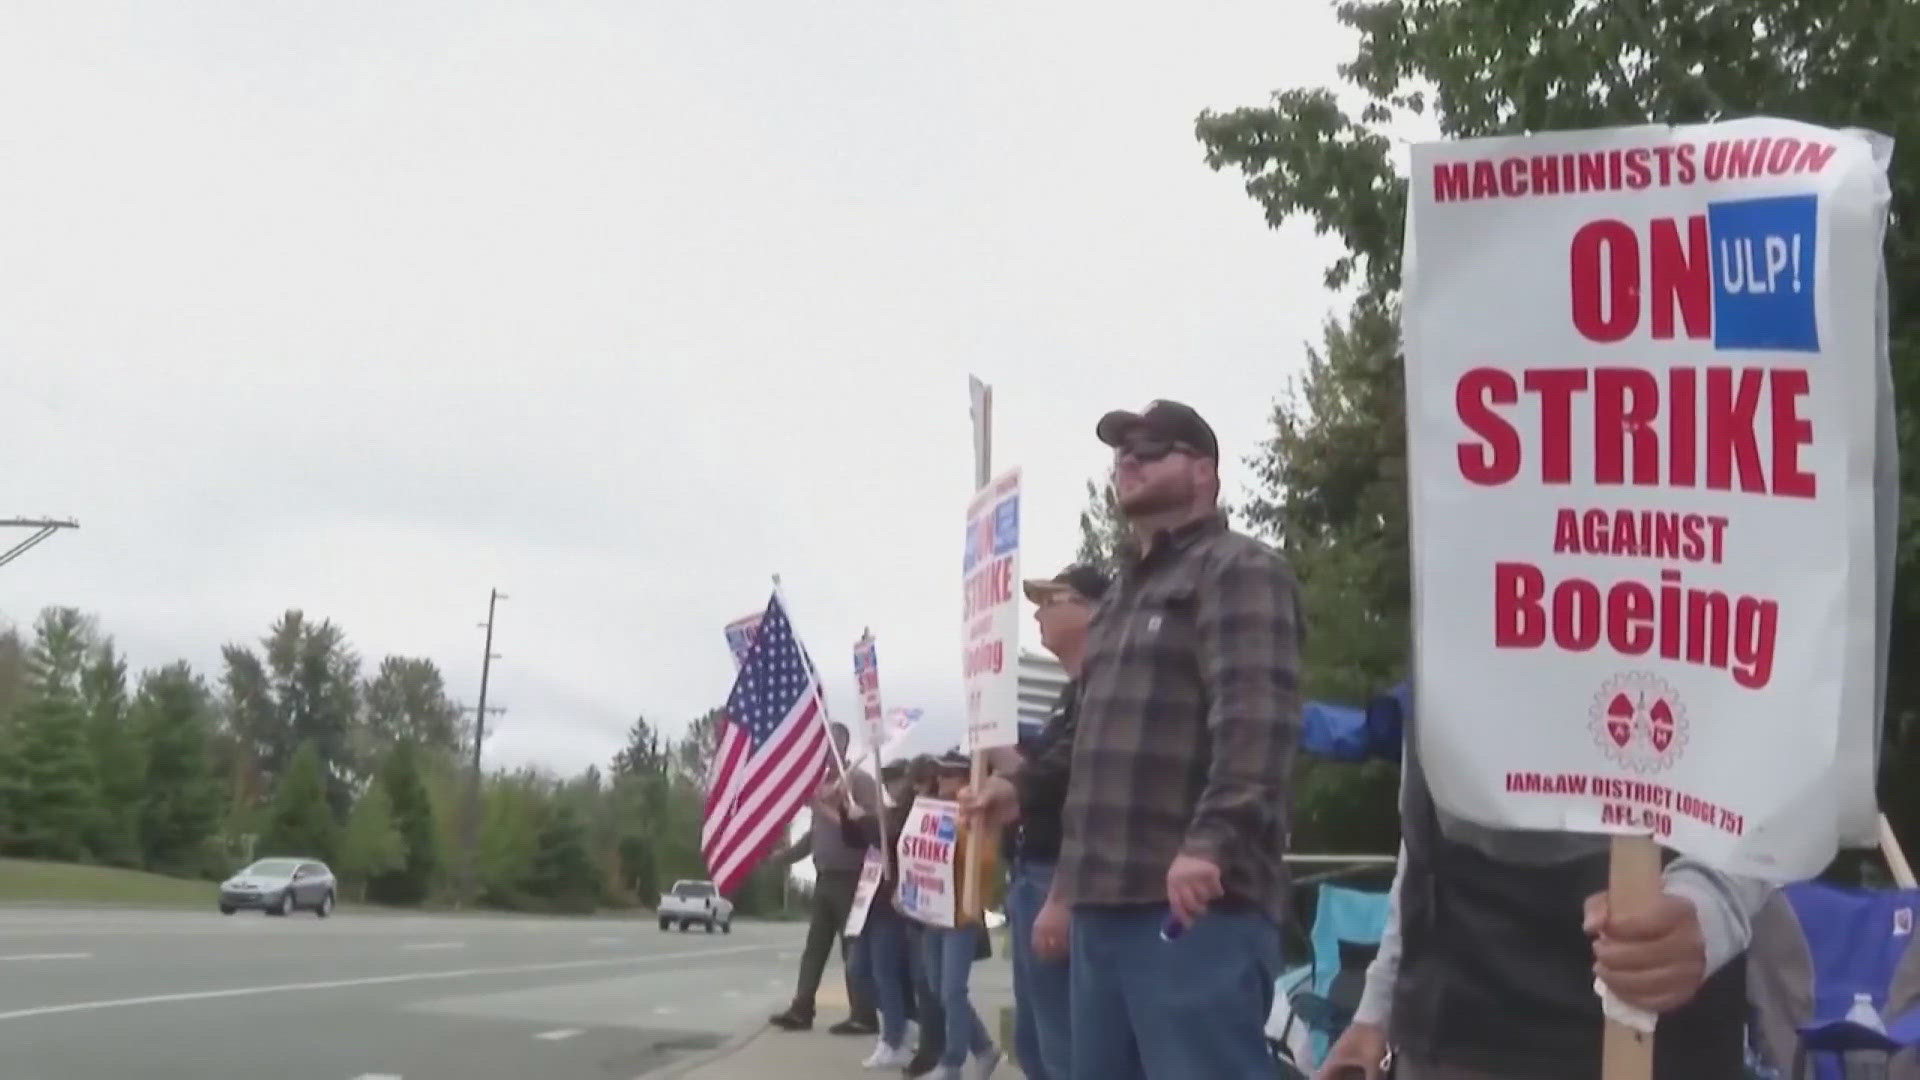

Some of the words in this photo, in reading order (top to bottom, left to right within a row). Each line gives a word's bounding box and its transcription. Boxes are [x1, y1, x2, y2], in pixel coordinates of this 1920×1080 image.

[1434, 143, 1696, 202] MACHINISTS
[1704, 137, 1837, 182] UNION
[1571, 215, 1713, 343] ON
[1720, 234, 1801, 294] ULP!
[1456, 367, 1816, 499] STRIKE
[1554, 508, 1729, 564] AGAINST
[1494, 562, 1779, 690] Boeing
[1506, 772, 1587, 795] IAM&AW
[1592, 776, 1672, 809] DISTRICT
[1676, 792, 1716, 825] LODGE
[1719, 809, 1743, 836] 751
[902, 835, 950, 864] STRIKE
